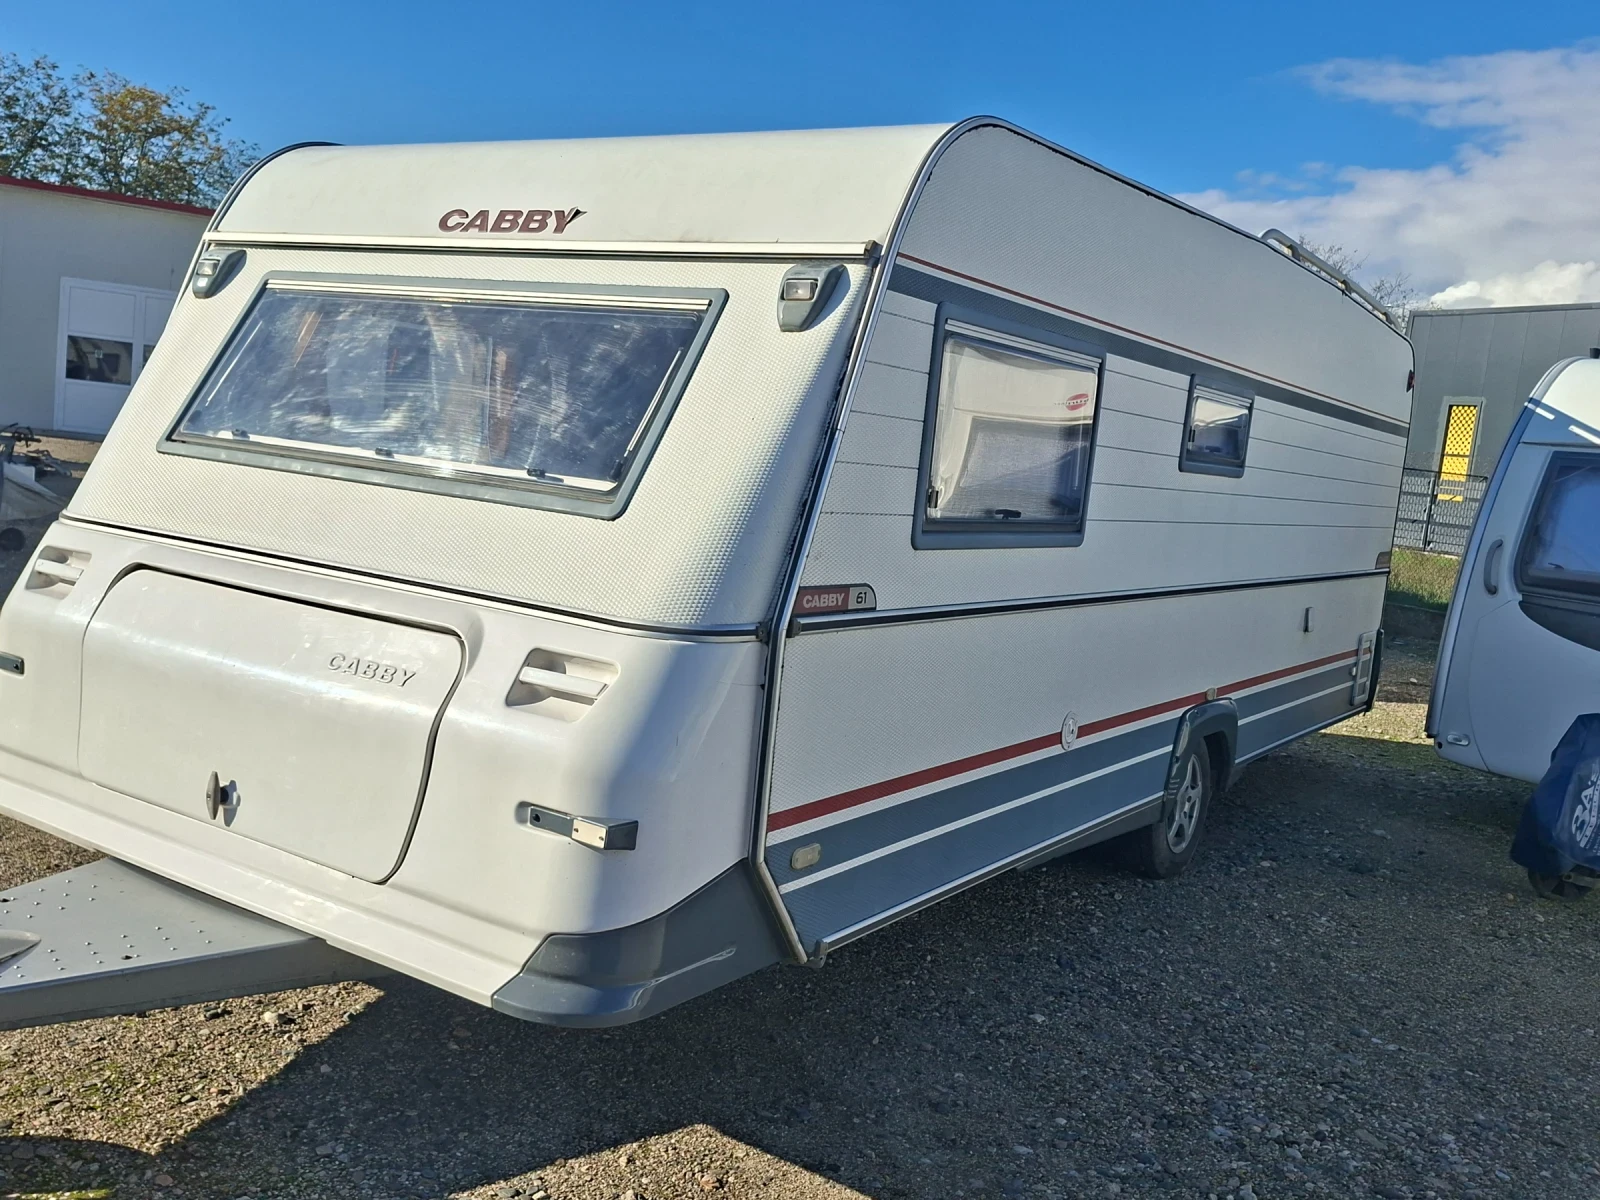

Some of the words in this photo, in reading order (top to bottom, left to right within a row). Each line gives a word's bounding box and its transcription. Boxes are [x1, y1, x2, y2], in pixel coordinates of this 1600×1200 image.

[438, 206, 587, 234] CABBY
[803, 593, 845, 608] CABBY
[856, 591, 867, 604] 61
[328, 652, 416, 688] CABBY
